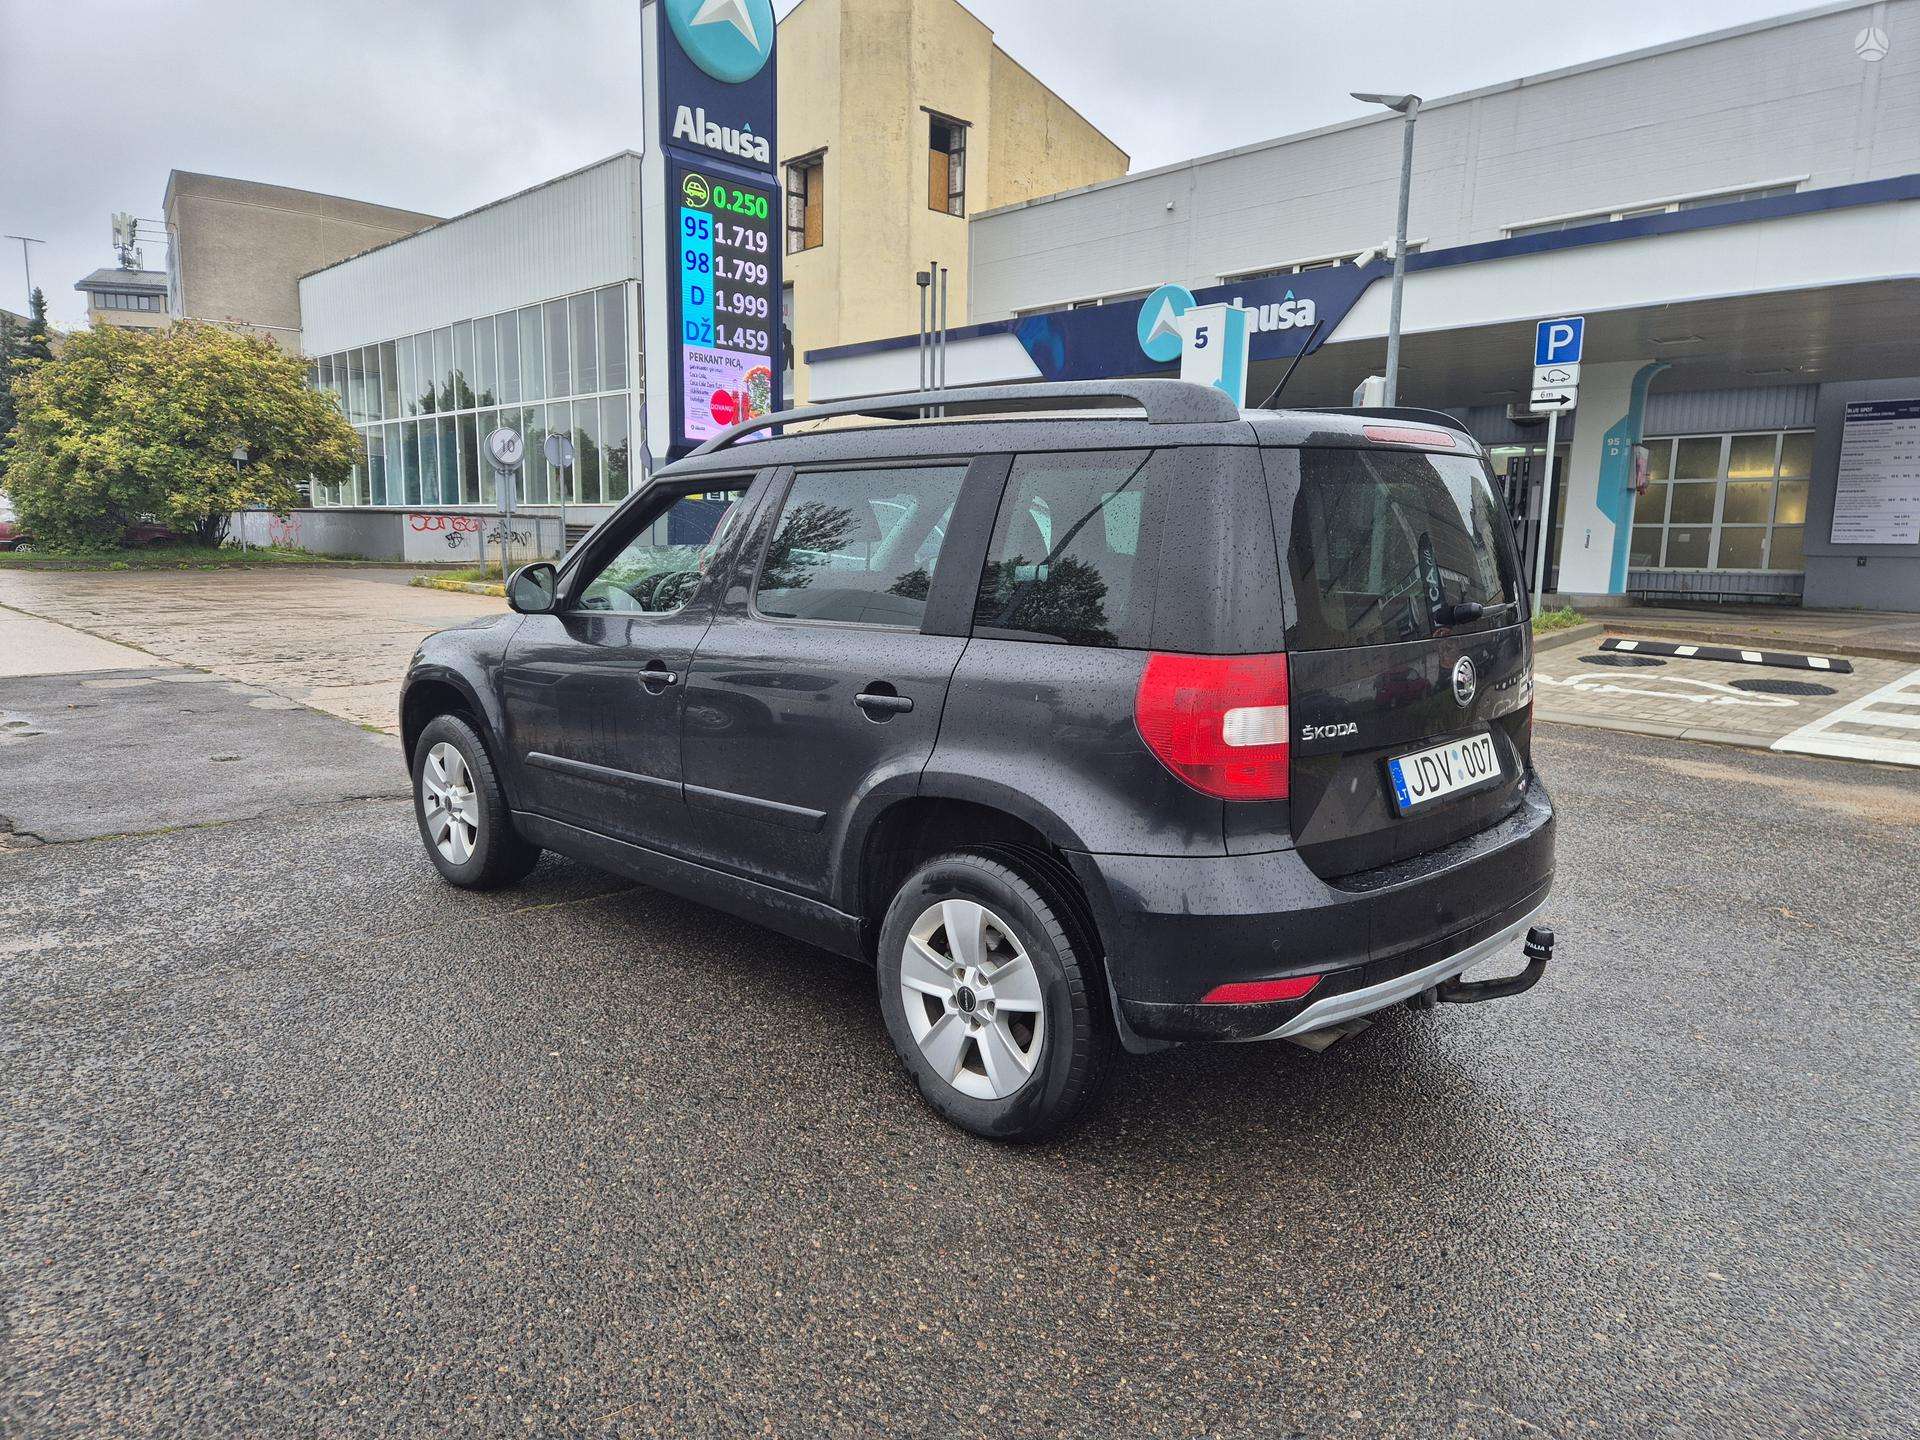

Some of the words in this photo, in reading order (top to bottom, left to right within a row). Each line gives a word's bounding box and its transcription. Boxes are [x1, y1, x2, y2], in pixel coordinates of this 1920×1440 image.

[713, 186, 768, 219] 0.250
[685, 216, 709, 240] 95
[715, 222, 768, 253] 1.719
[685, 250, 709, 273] 98
[715, 256, 768, 285] 1.799
[691, 285, 704, 305] D
[715, 290, 768, 318] 1.999
[685, 317, 712, 343] DŽ
[716, 324, 769, 351] 1.459
[1194, 326, 1208, 349] 5
[1547, 324, 1574, 360] P
[689, 351, 723, 366] PERKANT
[501, 439, 515, 452] 10
[1607, 438, 1620, 446] 95
[1610, 447, 1618, 456] D
[1301, 722, 1359, 740] ŠKODA
[1411, 750, 1453, 796] JDV
[1461, 738, 1493, 778] 007
[1397, 788, 1408, 800] LT
